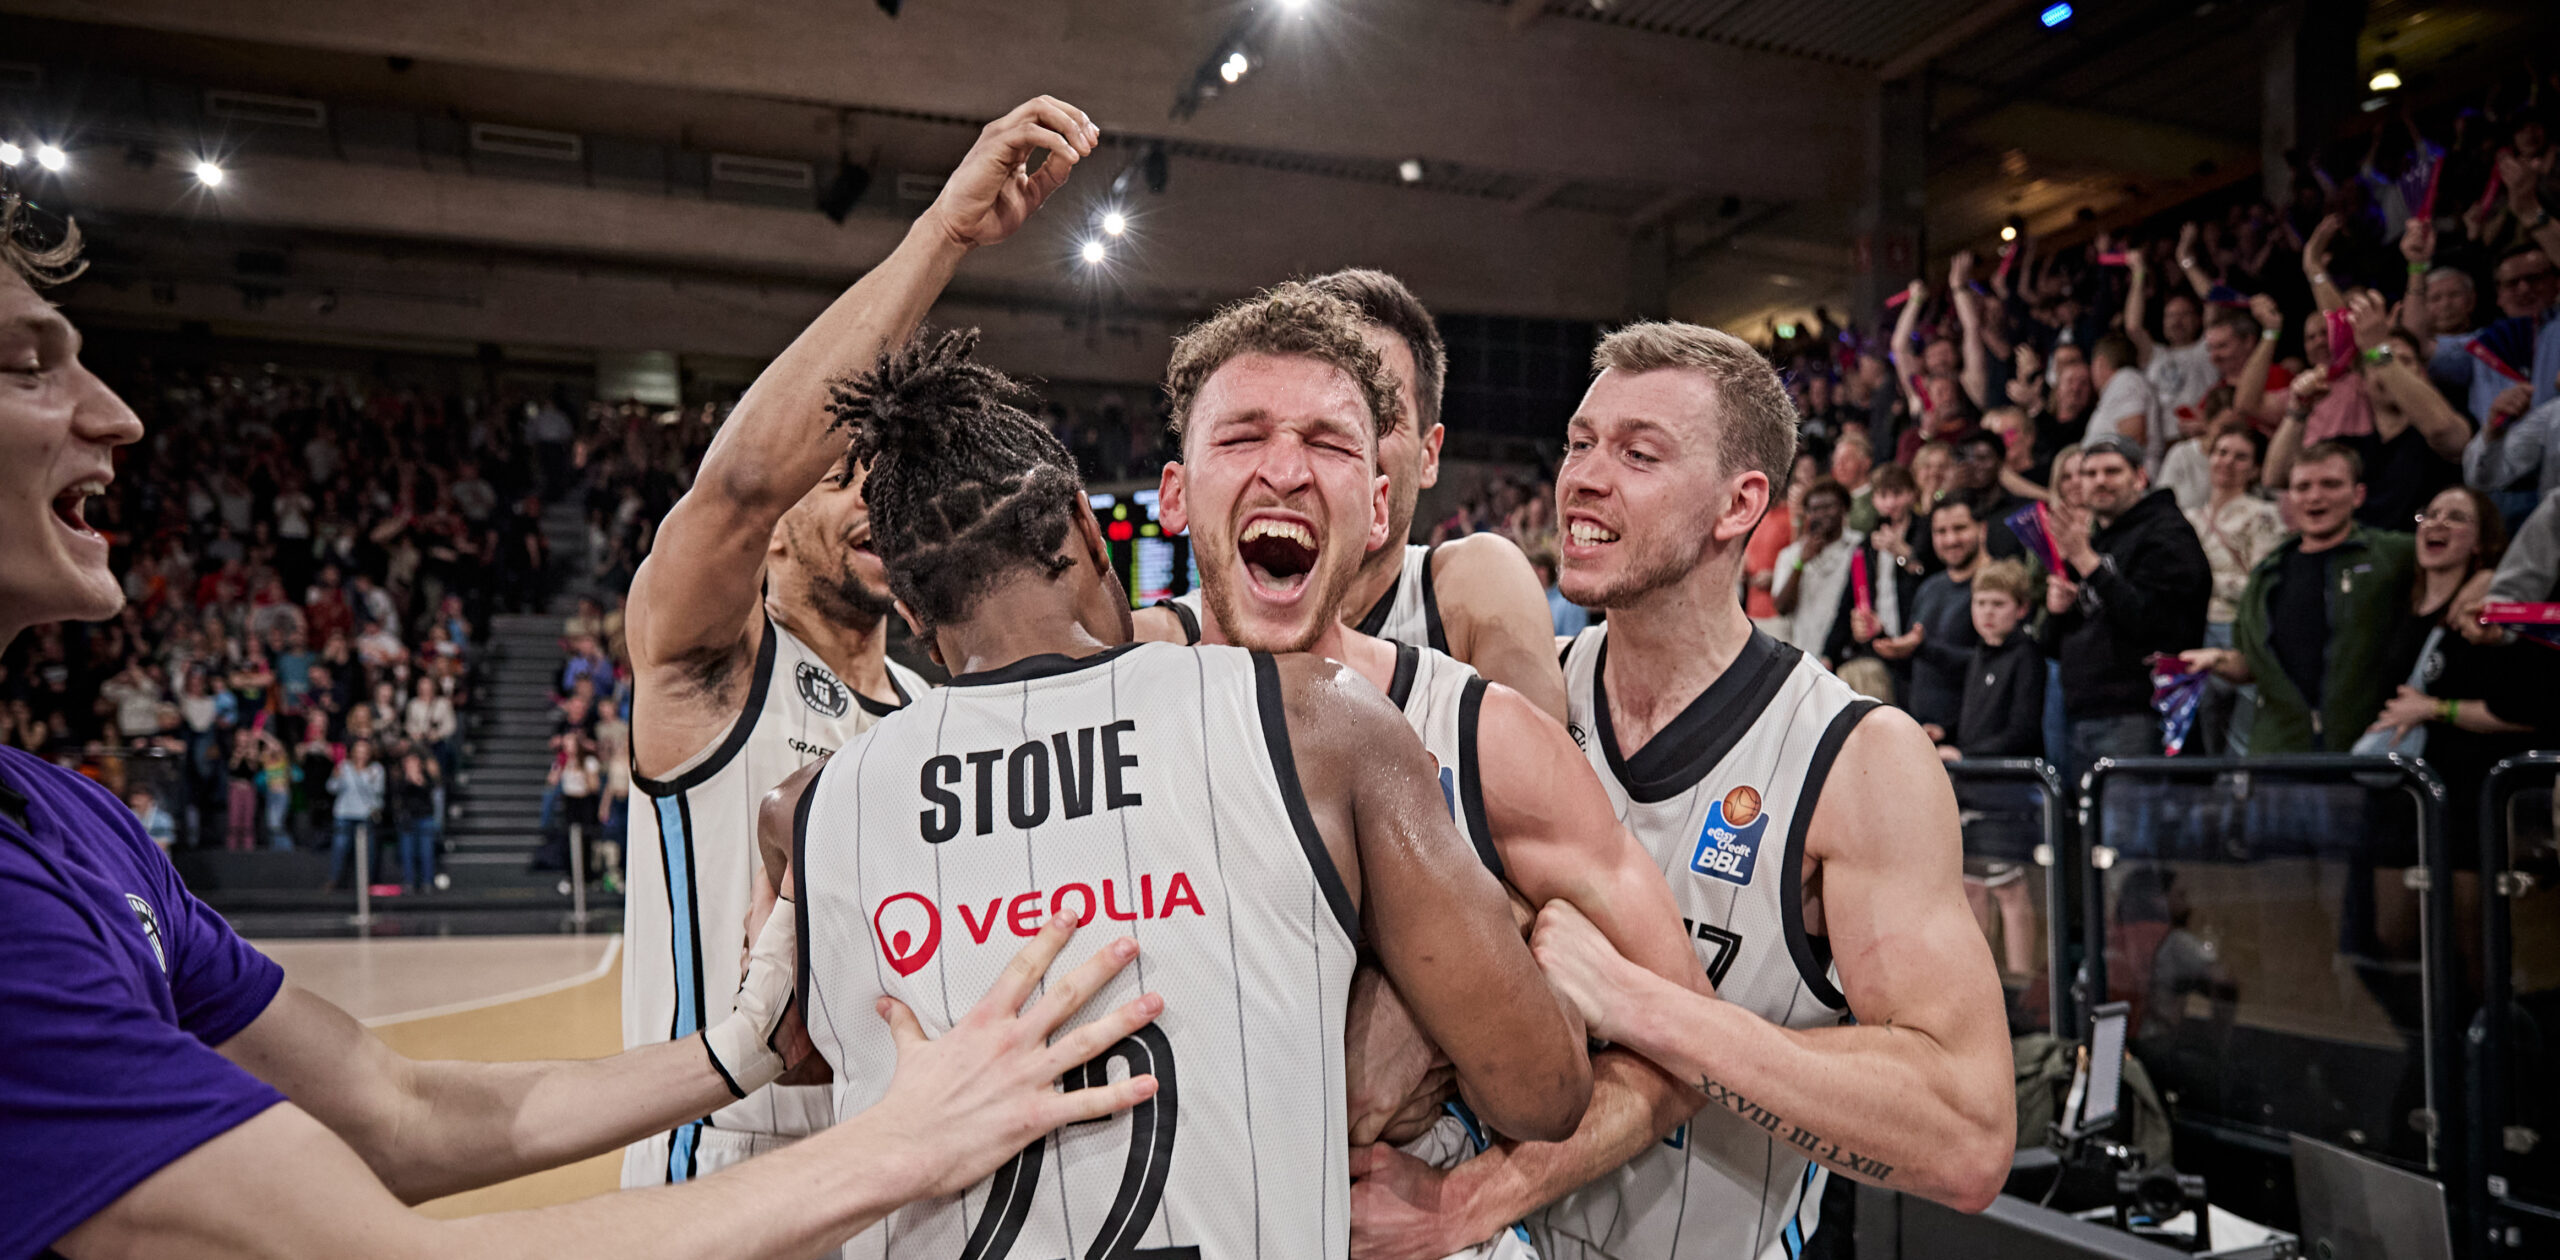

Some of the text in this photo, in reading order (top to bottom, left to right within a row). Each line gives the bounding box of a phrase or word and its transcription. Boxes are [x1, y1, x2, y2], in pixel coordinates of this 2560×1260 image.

[788, 738, 836, 756] CRAF
[920, 720, 1142, 844] STOVE
[1697, 846, 1744, 878] BBL
[958, 872, 1205, 945] VEOLIA
[1683, 917, 1743, 992] 7
